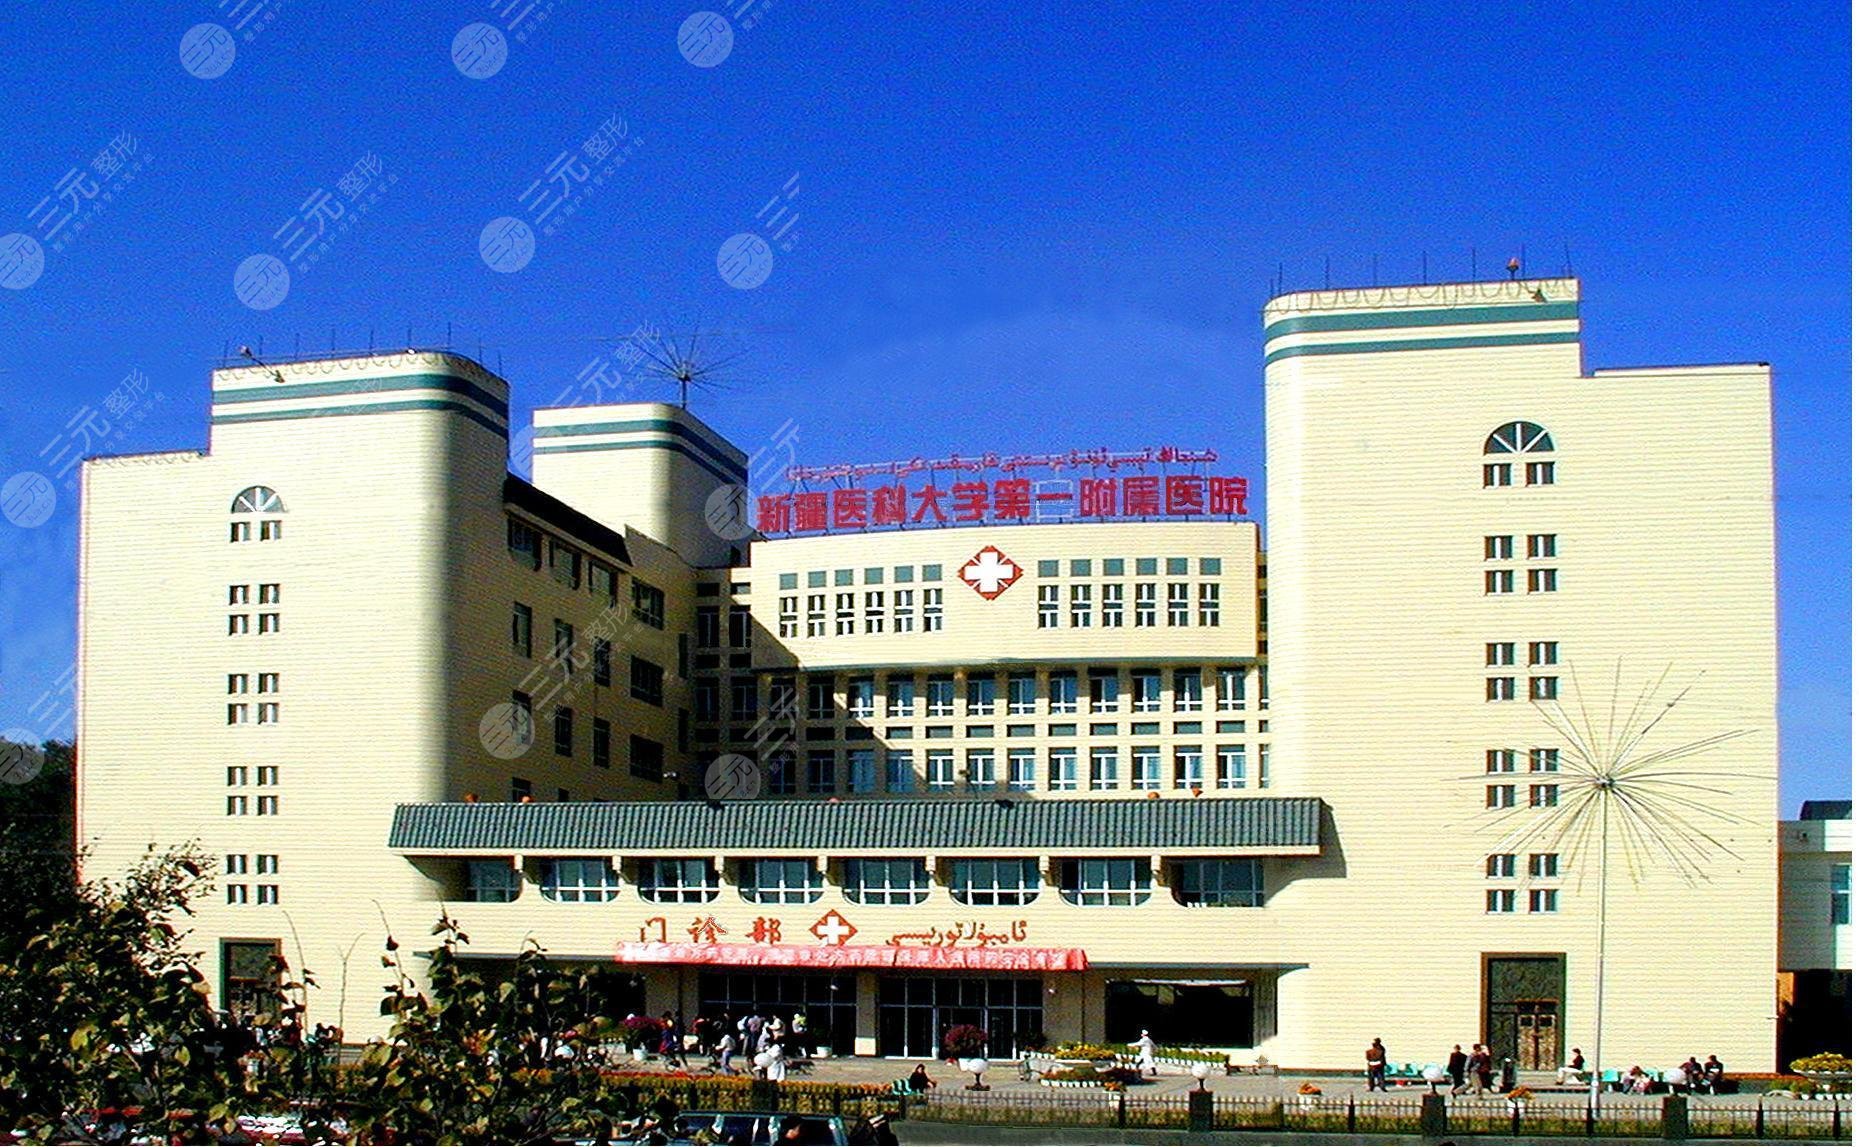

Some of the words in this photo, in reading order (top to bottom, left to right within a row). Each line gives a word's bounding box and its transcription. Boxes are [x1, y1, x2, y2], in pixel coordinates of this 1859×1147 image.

[757, 475, 1248, 532] 新疆医科大学第一附属医院
[639, 917, 783, 945] 门诊部
